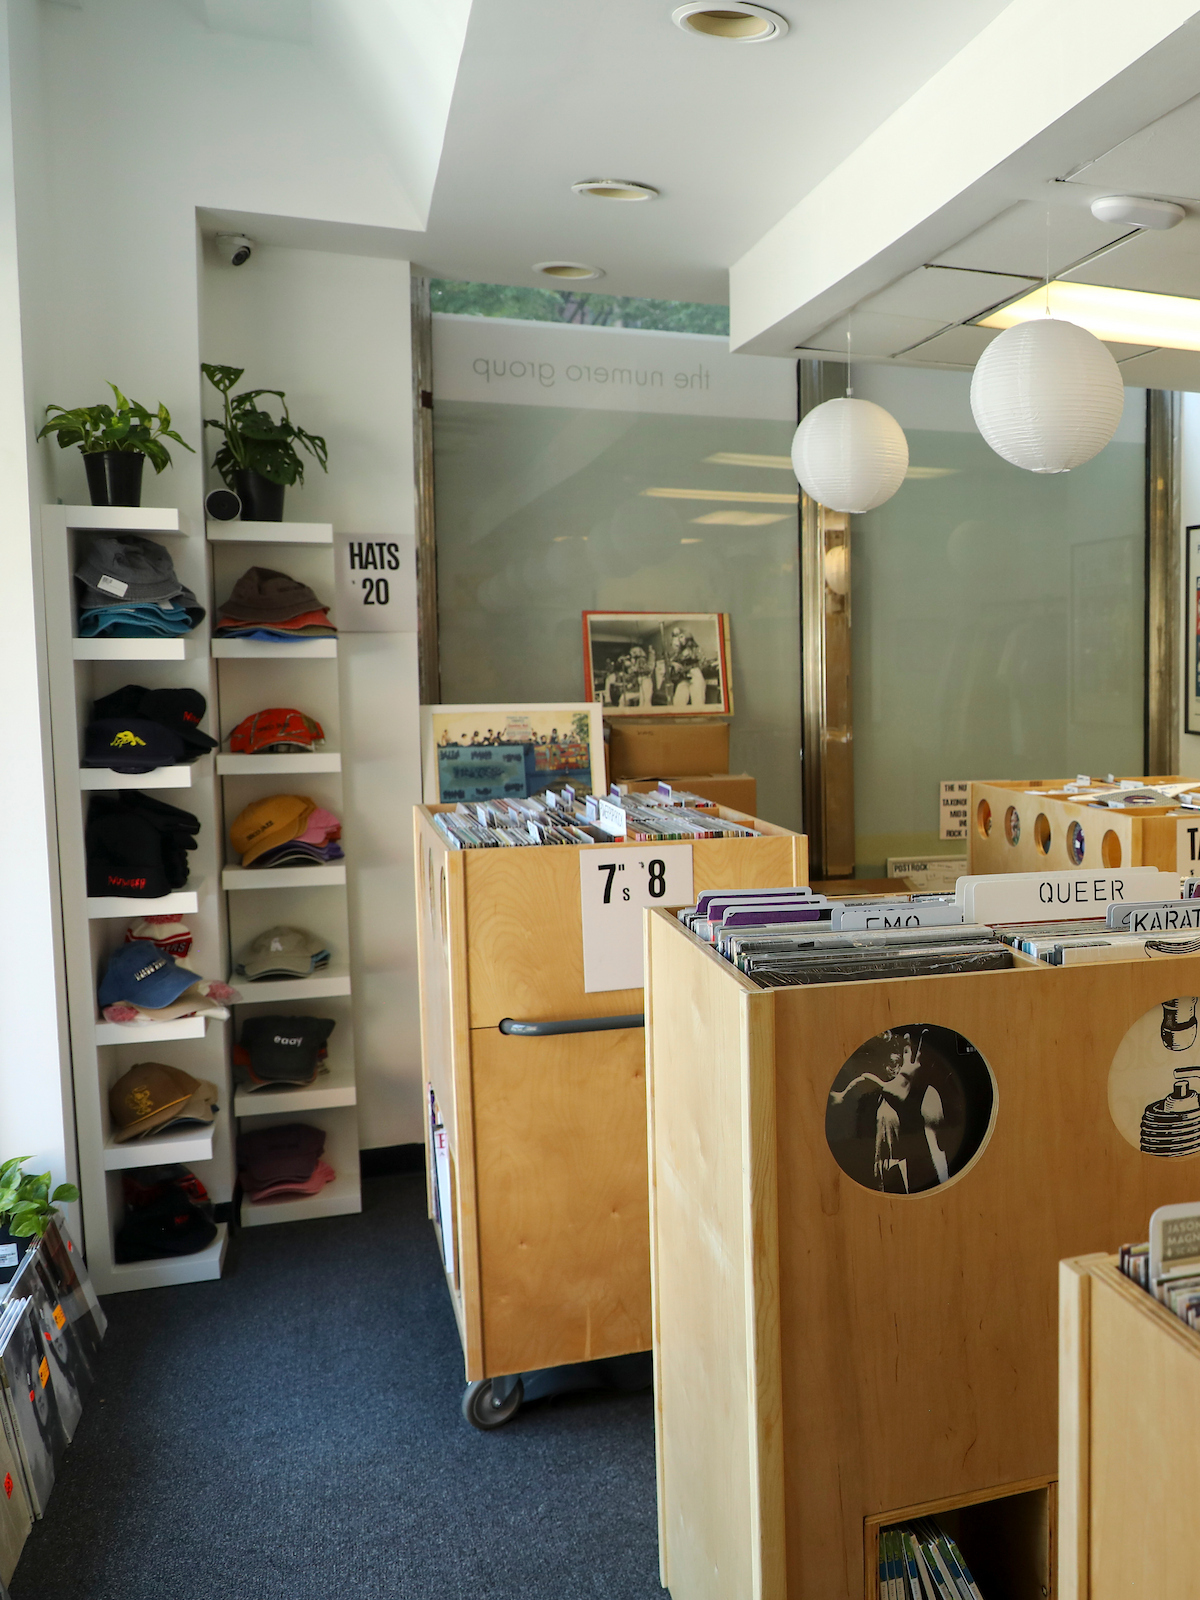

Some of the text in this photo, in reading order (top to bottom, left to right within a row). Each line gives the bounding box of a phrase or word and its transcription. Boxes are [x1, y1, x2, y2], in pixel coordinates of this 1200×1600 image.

[349, 542, 400, 570] HATS
[944, 784, 955, 792] THE
[1039, 879, 1125, 904] QUEER
